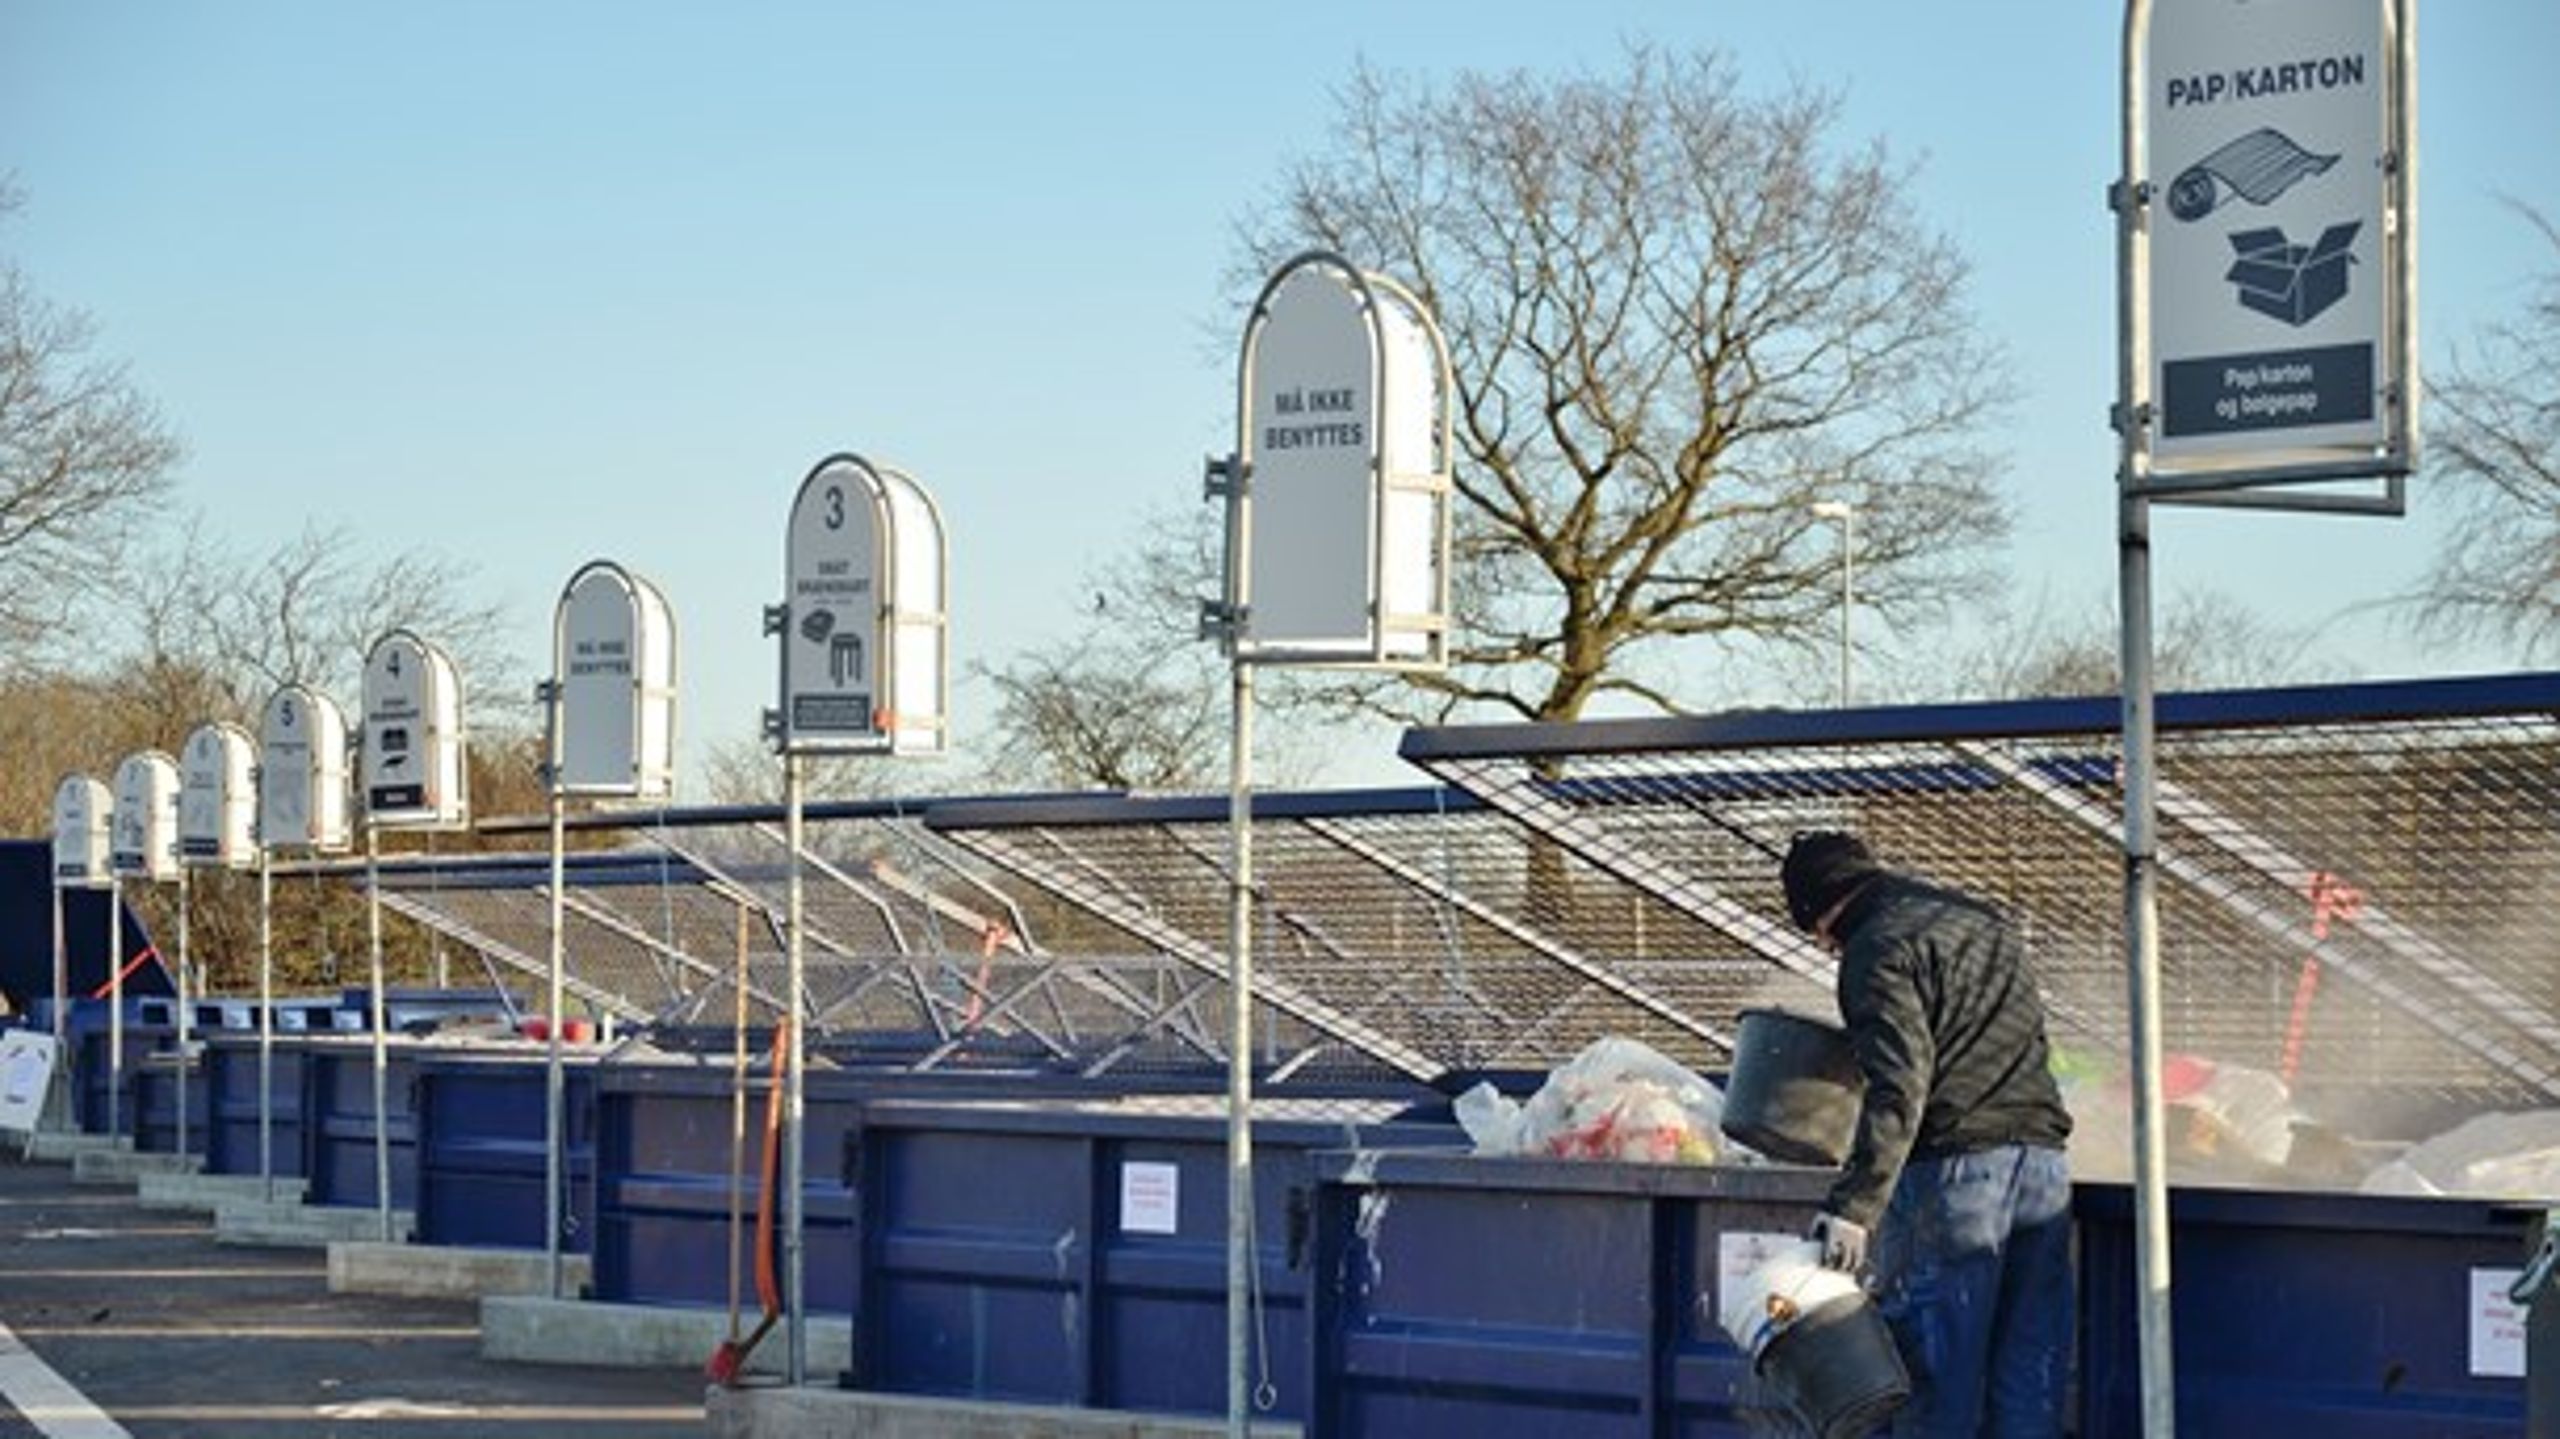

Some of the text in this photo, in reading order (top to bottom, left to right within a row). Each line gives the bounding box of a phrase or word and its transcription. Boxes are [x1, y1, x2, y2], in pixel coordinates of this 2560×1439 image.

[1275, 385, 1354, 415] MÅ IKKE
[2215, 398, 2238, 420] og
[1266, 421, 1363, 450] BENYTTES
[825, 486, 844, 530] 3
[386, 650, 400, 679] 4
